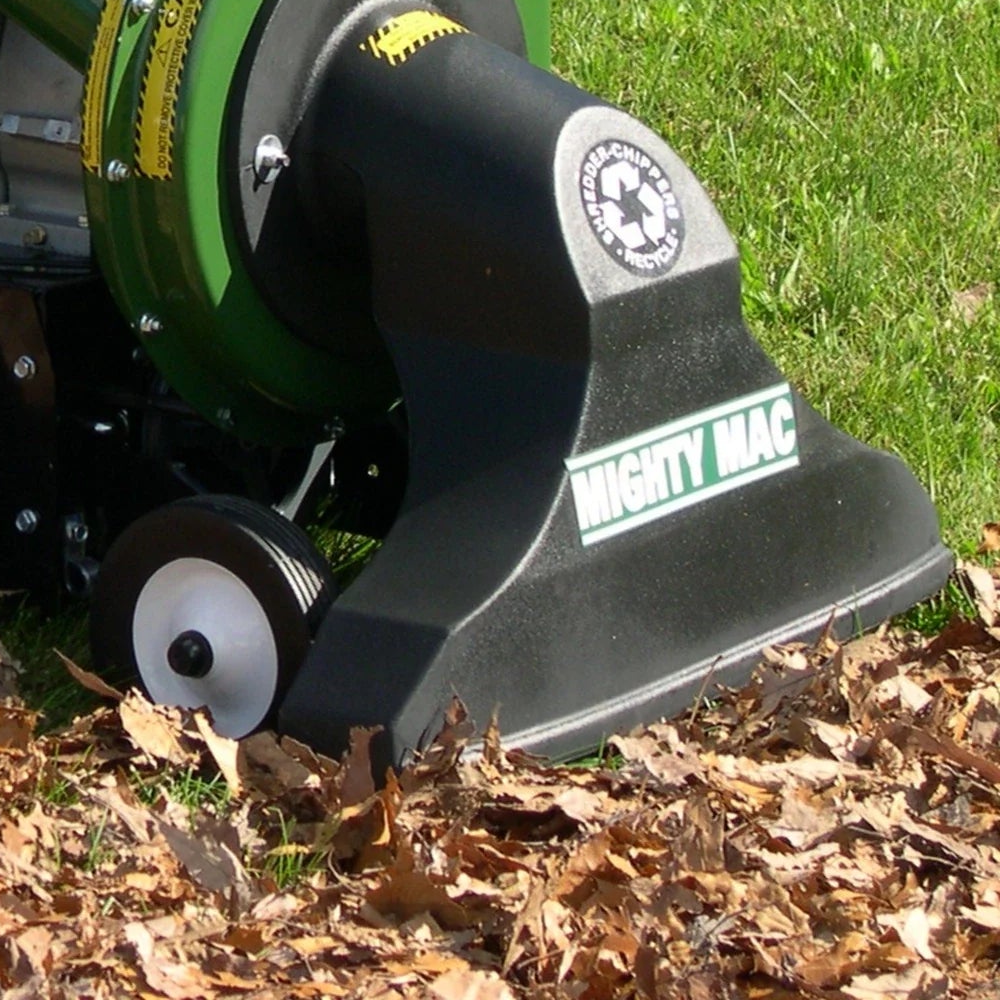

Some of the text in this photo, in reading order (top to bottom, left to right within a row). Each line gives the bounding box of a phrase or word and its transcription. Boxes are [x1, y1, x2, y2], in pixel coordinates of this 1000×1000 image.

[179, 5, 194, 36] COVER
[165, 37, 184, 95] PROTECTIVE
[160, 95, 172, 132] REMOVE
[157, 135, 167, 153] NOT
[157, 155, 165, 168] DO
[624, 231, 679, 269] RECYCLE
[570, 398, 796, 530] MIGHTY MAC
